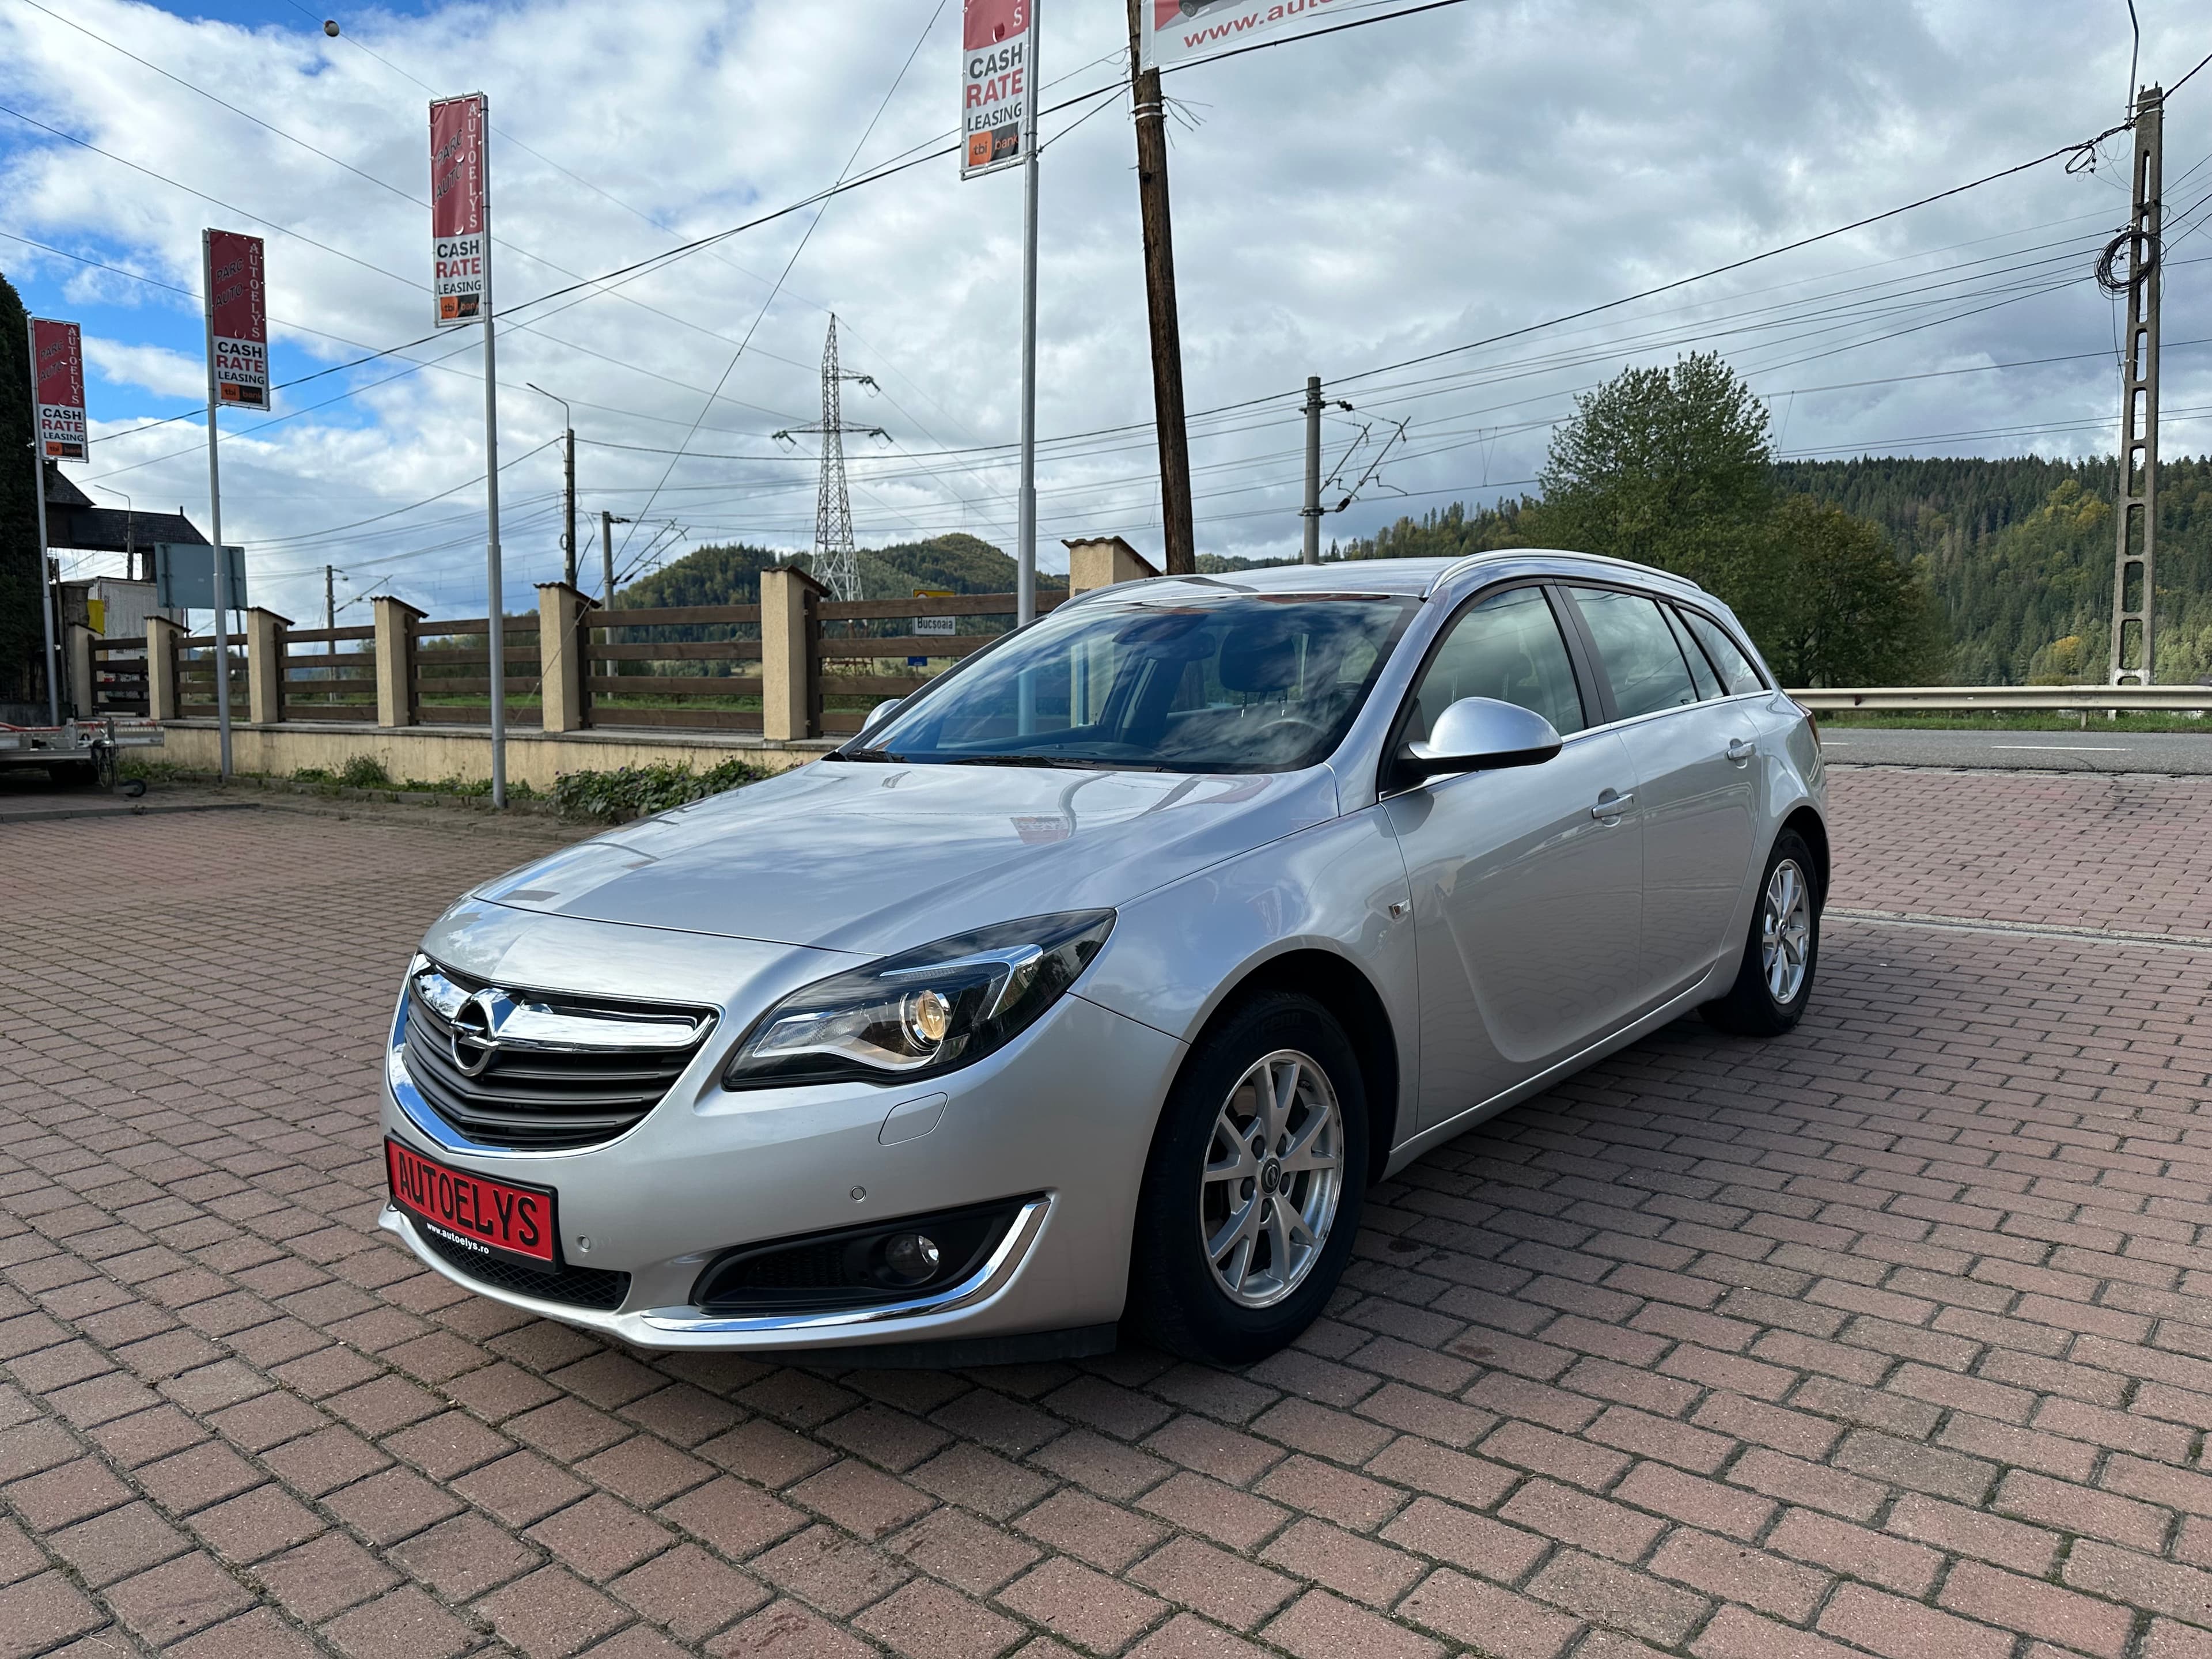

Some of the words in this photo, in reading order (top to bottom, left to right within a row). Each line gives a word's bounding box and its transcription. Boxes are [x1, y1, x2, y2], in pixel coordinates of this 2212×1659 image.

[969, 42, 1023, 79] CASH
[966, 67, 1024, 109] RATE
[968, 101, 1022, 132] LEASING
[437, 128, 464, 170] PARC
[974, 141, 987, 156] tbi
[994, 134, 1019, 150] bank
[467, 103, 478, 229] AUTOELYS
[435, 162, 463, 202] AUTO
[437, 240, 480, 258] CASH
[216, 257, 244, 284] PARC
[435, 257, 481, 279] RATE
[214, 282, 244, 309] AUTO
[249, 243, 263, 339] AUTOELYS
[438, 280, 482, 295] LEASING
[444, 301, 455, 313] tbi
[460, 298, 479, 312] bank
[40, 341, 65, 361] PARC
[217, 341, 263, 358] CASH
[39, 361, 64, 382] AUTO
[68, 327, 80, 404] AUTOELYS
[216, 355, 264, 373] RATE
[218, 370, 265, 385] LEASING
[224, 387, 237, 397] tbi
[242, 388, 262, 400] bank
[41, 419, 84, 432] RATE
[43, 408, 82, 421] CASH
[43, 431, 84, 442] LEASING
[918, 617, 953, 631] Bucșoaia
[398, 1151, 539, 1247] AUTOELYS
[426, 1222, 490, 1255] www.autoelys.ro
